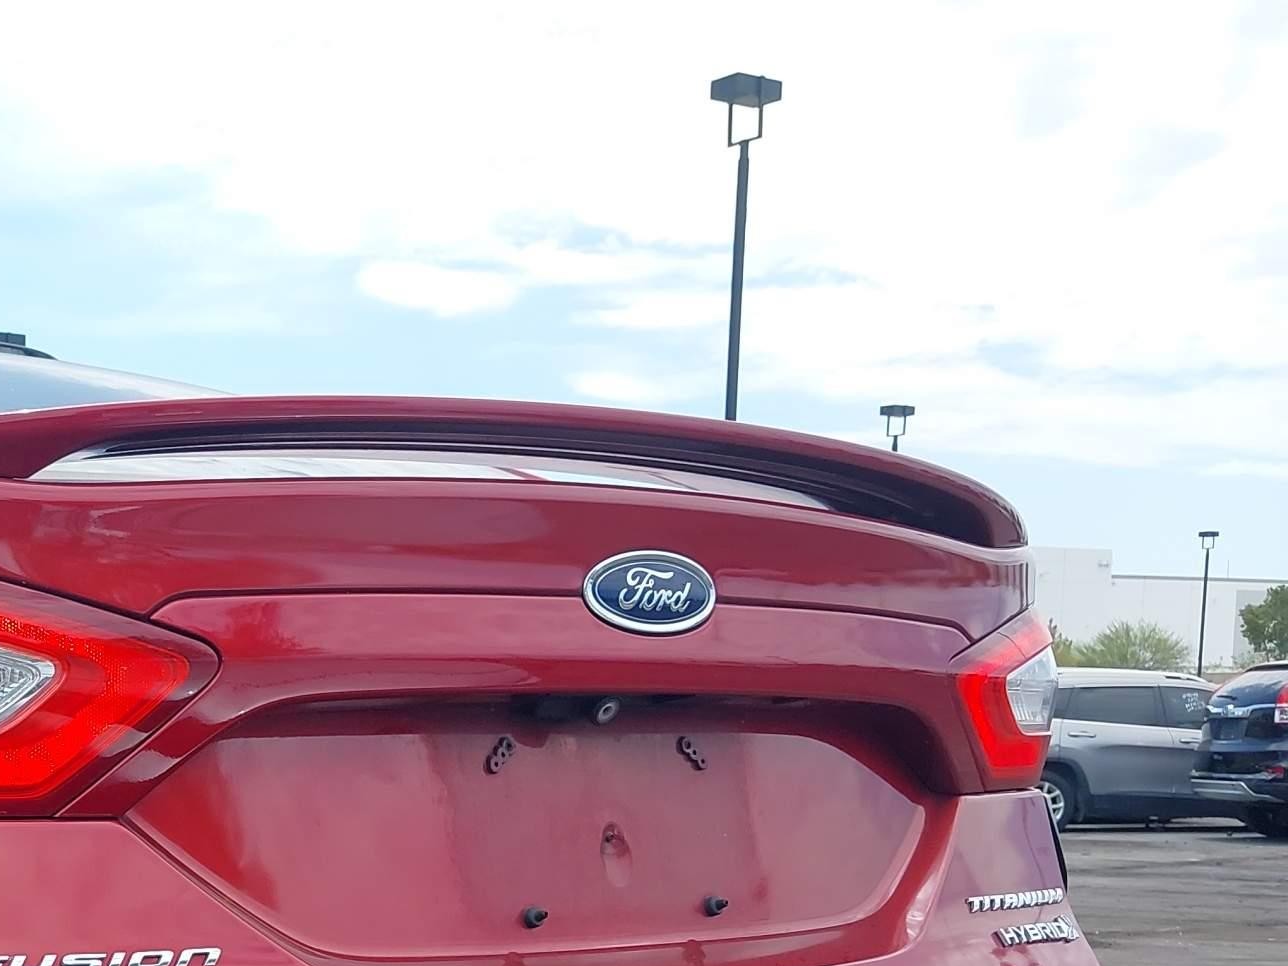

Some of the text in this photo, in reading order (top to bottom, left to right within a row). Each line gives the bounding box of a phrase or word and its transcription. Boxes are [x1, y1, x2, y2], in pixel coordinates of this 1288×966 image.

[618, 566, 692, 613] Ford
[966, 887, 1064, 913] TITANIUM
[993, 919, 1066, 947] HYBRID
